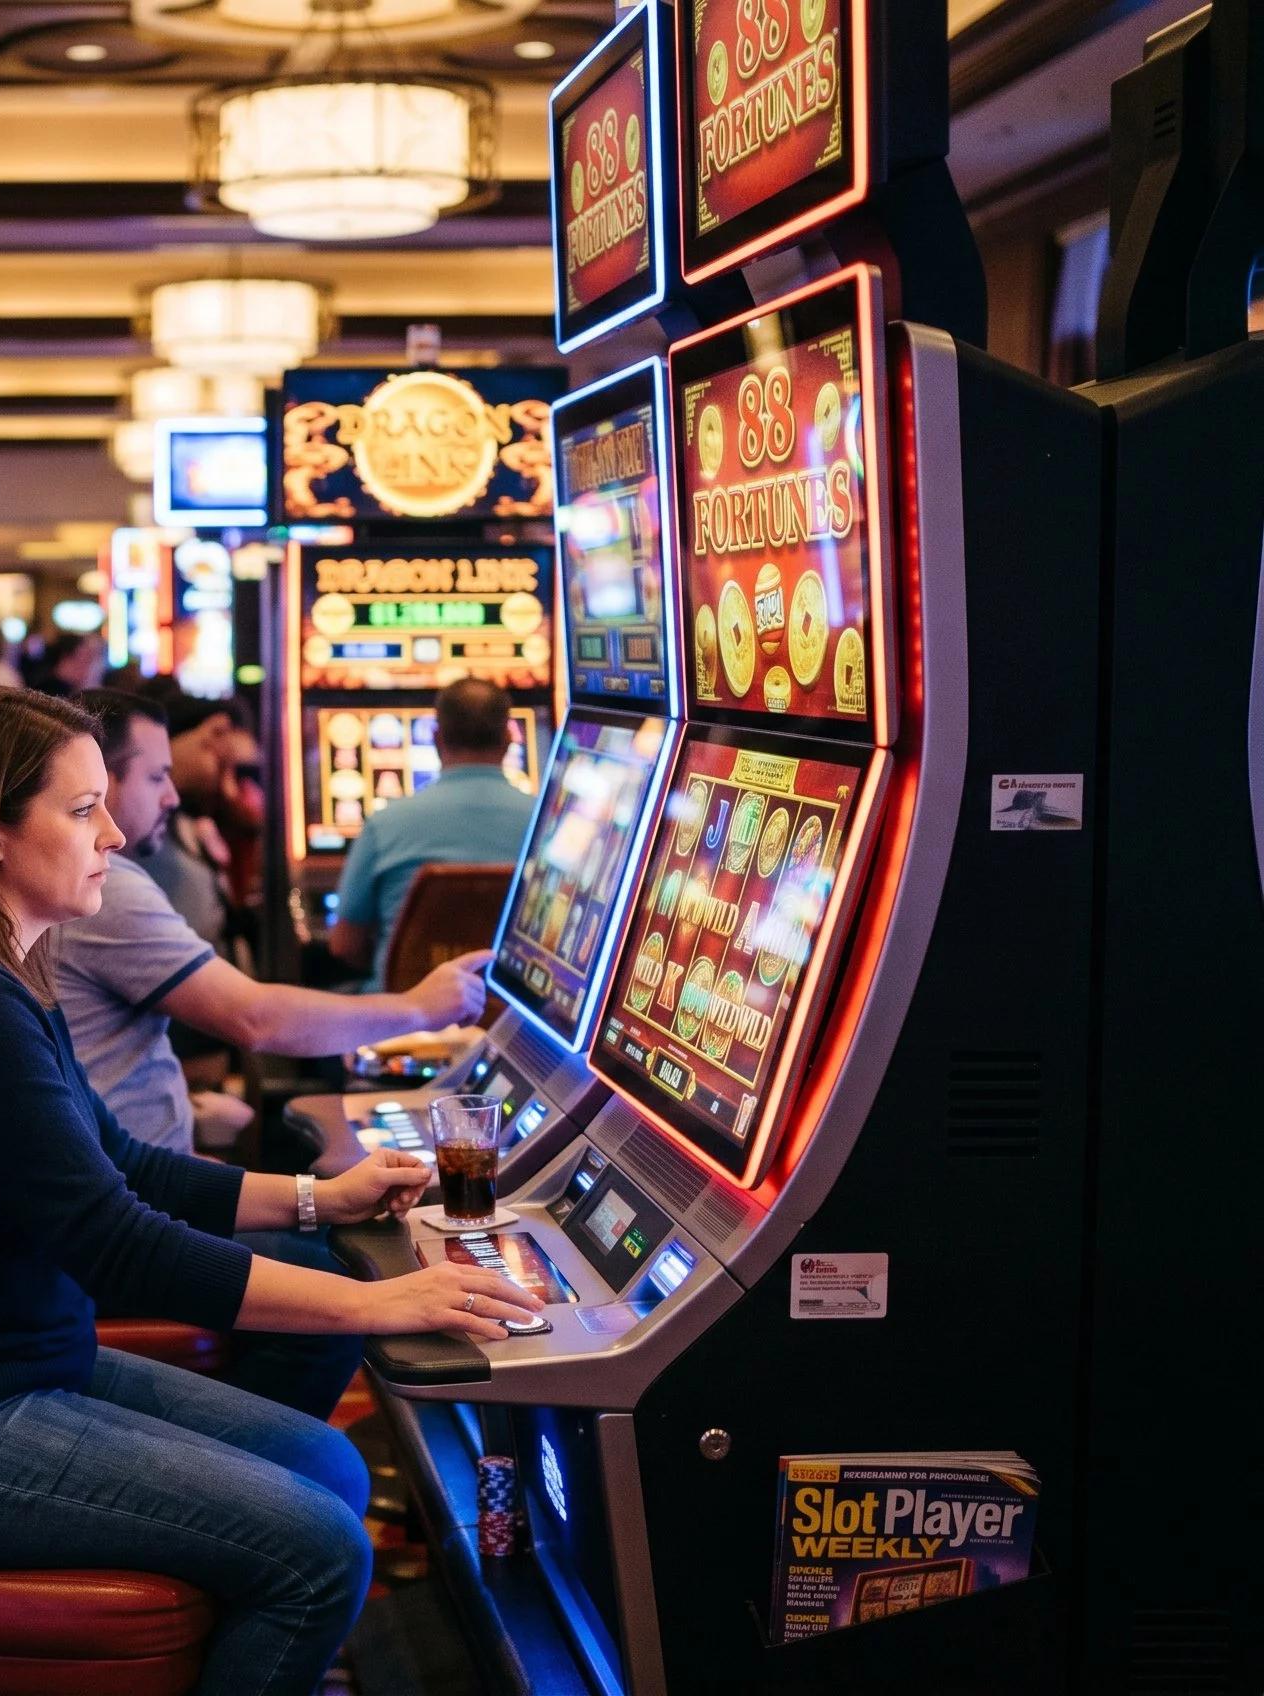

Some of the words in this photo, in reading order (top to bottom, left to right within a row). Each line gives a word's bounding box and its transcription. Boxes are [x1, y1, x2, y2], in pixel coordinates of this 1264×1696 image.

[586, 108, 620, 197] 88
[700, 34, 836, 184] FORTUNES
[566, 169, 647, 275] FORTUNES
[738, 365, 797, 468] 88
[693, 460, 853, 556] FORTUNES
[706, 799, 730, 848] J
[734, 901, 761, 955] A
[657, 961, 685, 1011] K
[735, 1004, 773, 1052] WILD
[792, 1487, 879, 1535] Slot
[883, 1488, 1024, 1548] Player
[792, 1537, 944, 1559] WEEKLY
